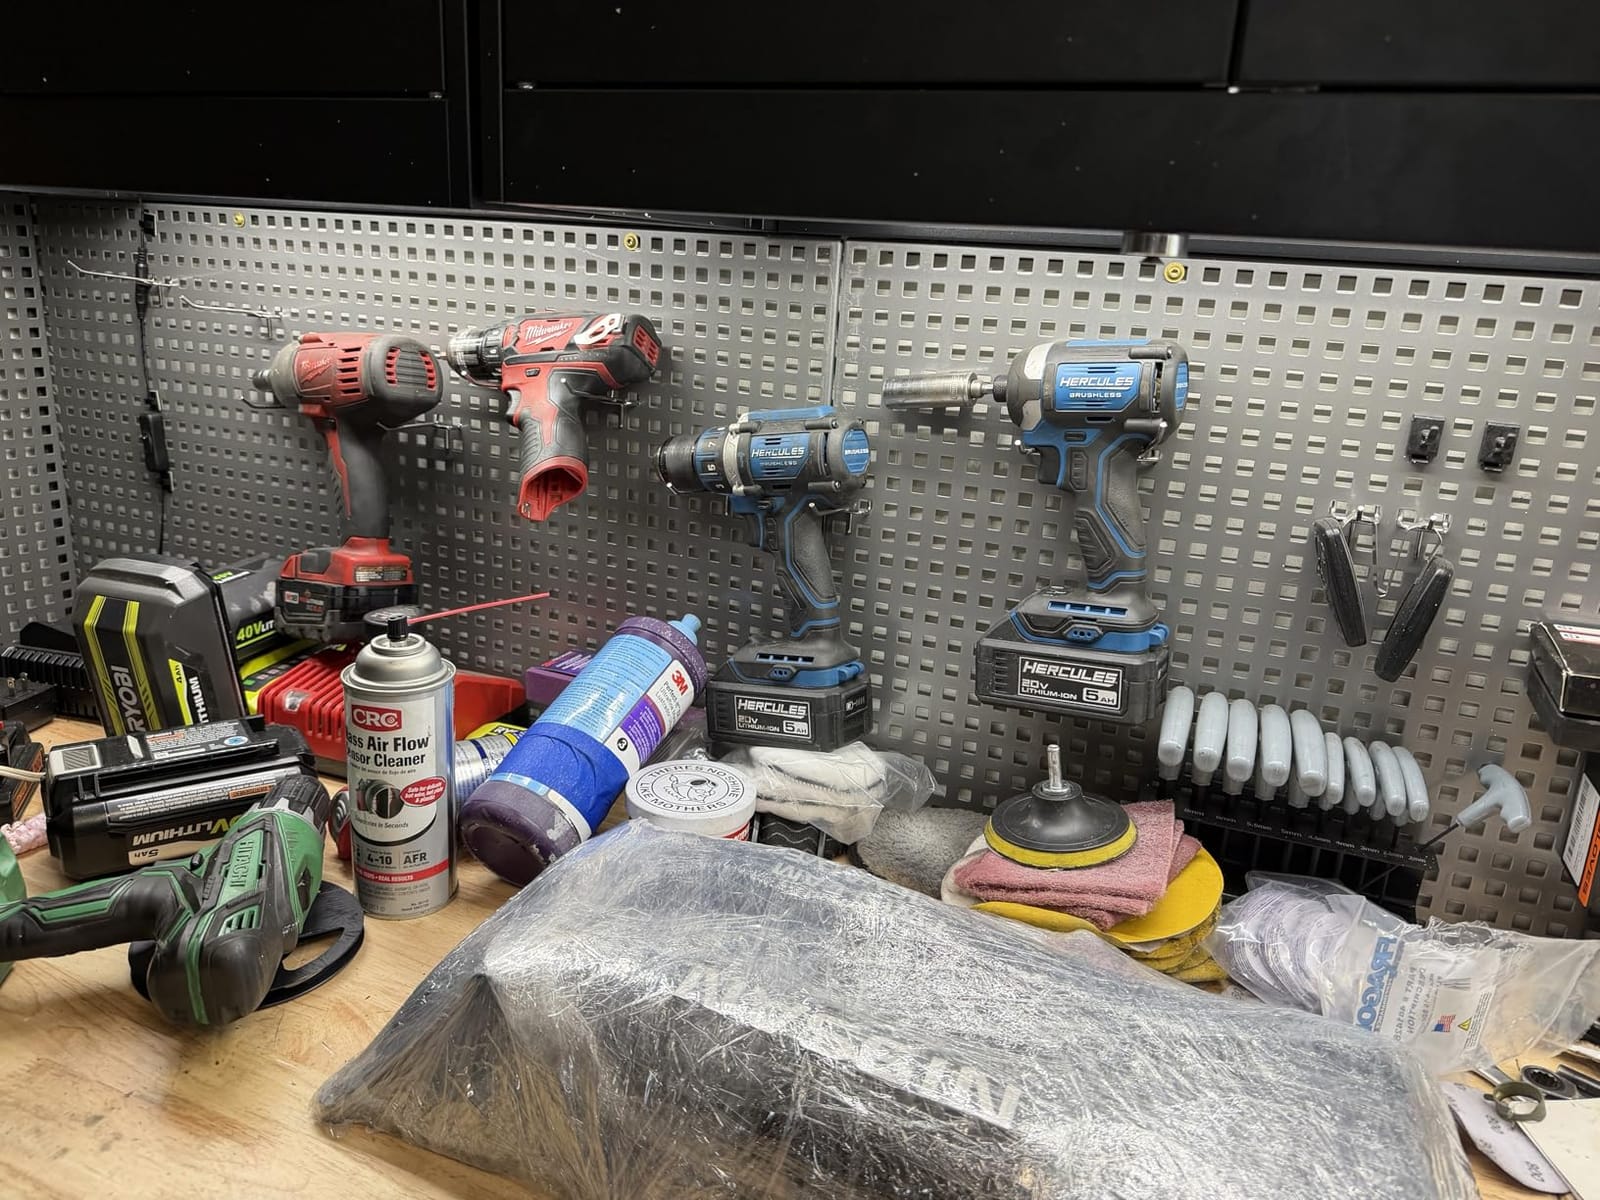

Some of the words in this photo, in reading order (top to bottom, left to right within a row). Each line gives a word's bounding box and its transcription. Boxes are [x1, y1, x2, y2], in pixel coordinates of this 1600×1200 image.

[1060, 376, 1134, 387] HERCULES
[751, 447, 805, 458] HERCULES
[1022, 661, 1119, 684] HERCULES
[671, 670, 689, 696] 3M
[110, 665, 147, 733] RYOBI
[188, 676, 209, 724] ITHIUM
[1021, 687, 1078, 700] LITHIUM-ION
[737, 699, 807, 716] HERCULES
[353, 708, 400, 728] CRC
[738, 722, 780, 732] LITHIUM-ION
[346, 732, 364, 749] ass
[367, 736, 389, 752] Air
[393, 736, 429, 752] Flow
[374, 754, 426, 768] Cleaner
[707, 767, 727, 777] NO
[724, 775, 740, 799] SHINE
[640, 782, 653, 799] LIKE
[650, 797, 727, 812] MOTHERS
[230, 841, 254, 887] HITACHI
[367, 854, 392, 865] 4-10
[404, 853, 427, 865] AFR
